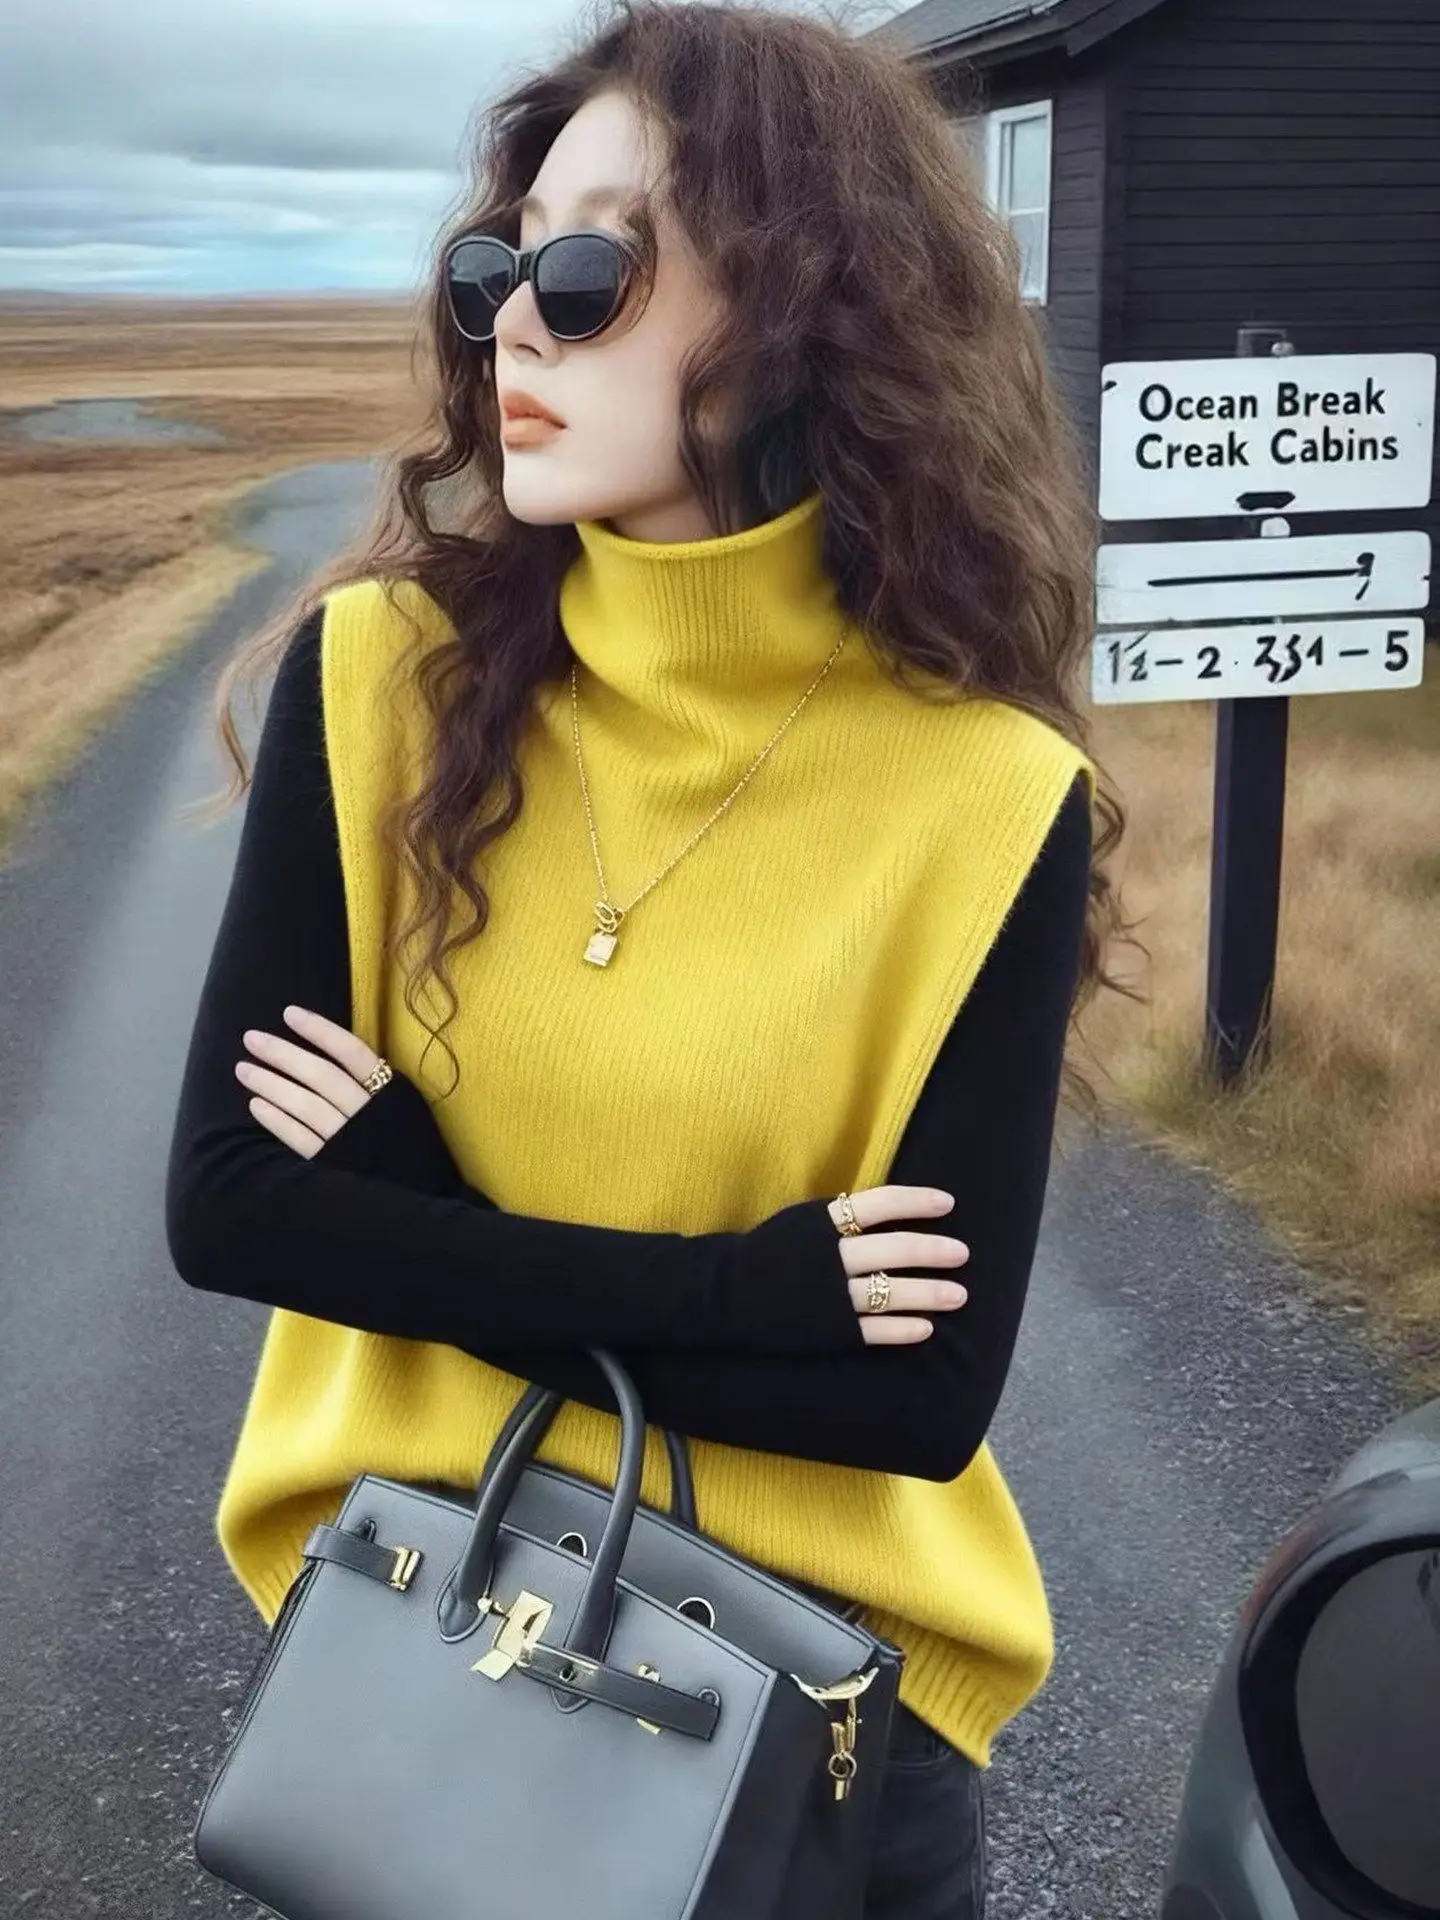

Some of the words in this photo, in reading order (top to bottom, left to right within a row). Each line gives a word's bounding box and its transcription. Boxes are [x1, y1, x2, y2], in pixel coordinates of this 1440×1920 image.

[1139, 383, 1258, 422] Ocean
[1277, 377, 1386, 418] Break
[1135, 430, 1250, 470] Creak
[1270, 425, 1399, 465] Cabins
